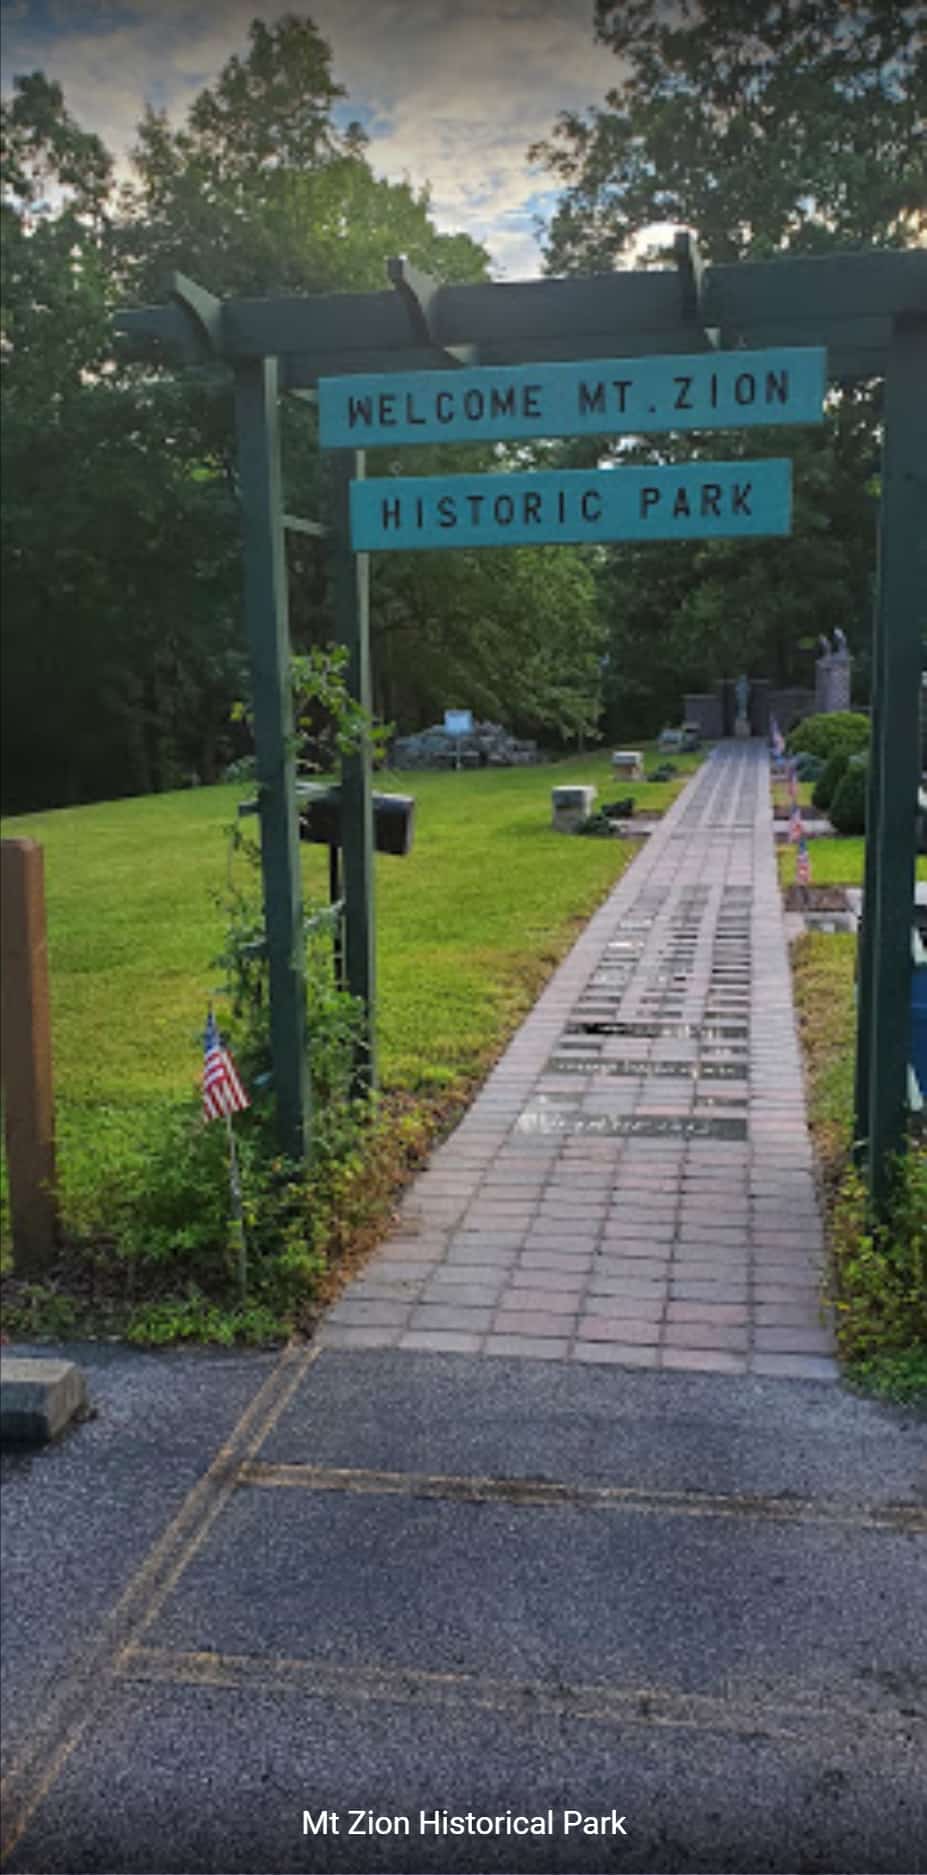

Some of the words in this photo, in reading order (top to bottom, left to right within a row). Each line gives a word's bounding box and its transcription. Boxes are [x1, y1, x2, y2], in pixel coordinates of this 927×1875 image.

[346, 384, 544, 430] WELCOME
[381, 489, 603, 530] HISTORIC
[639, 483, 755, 520] PARK
